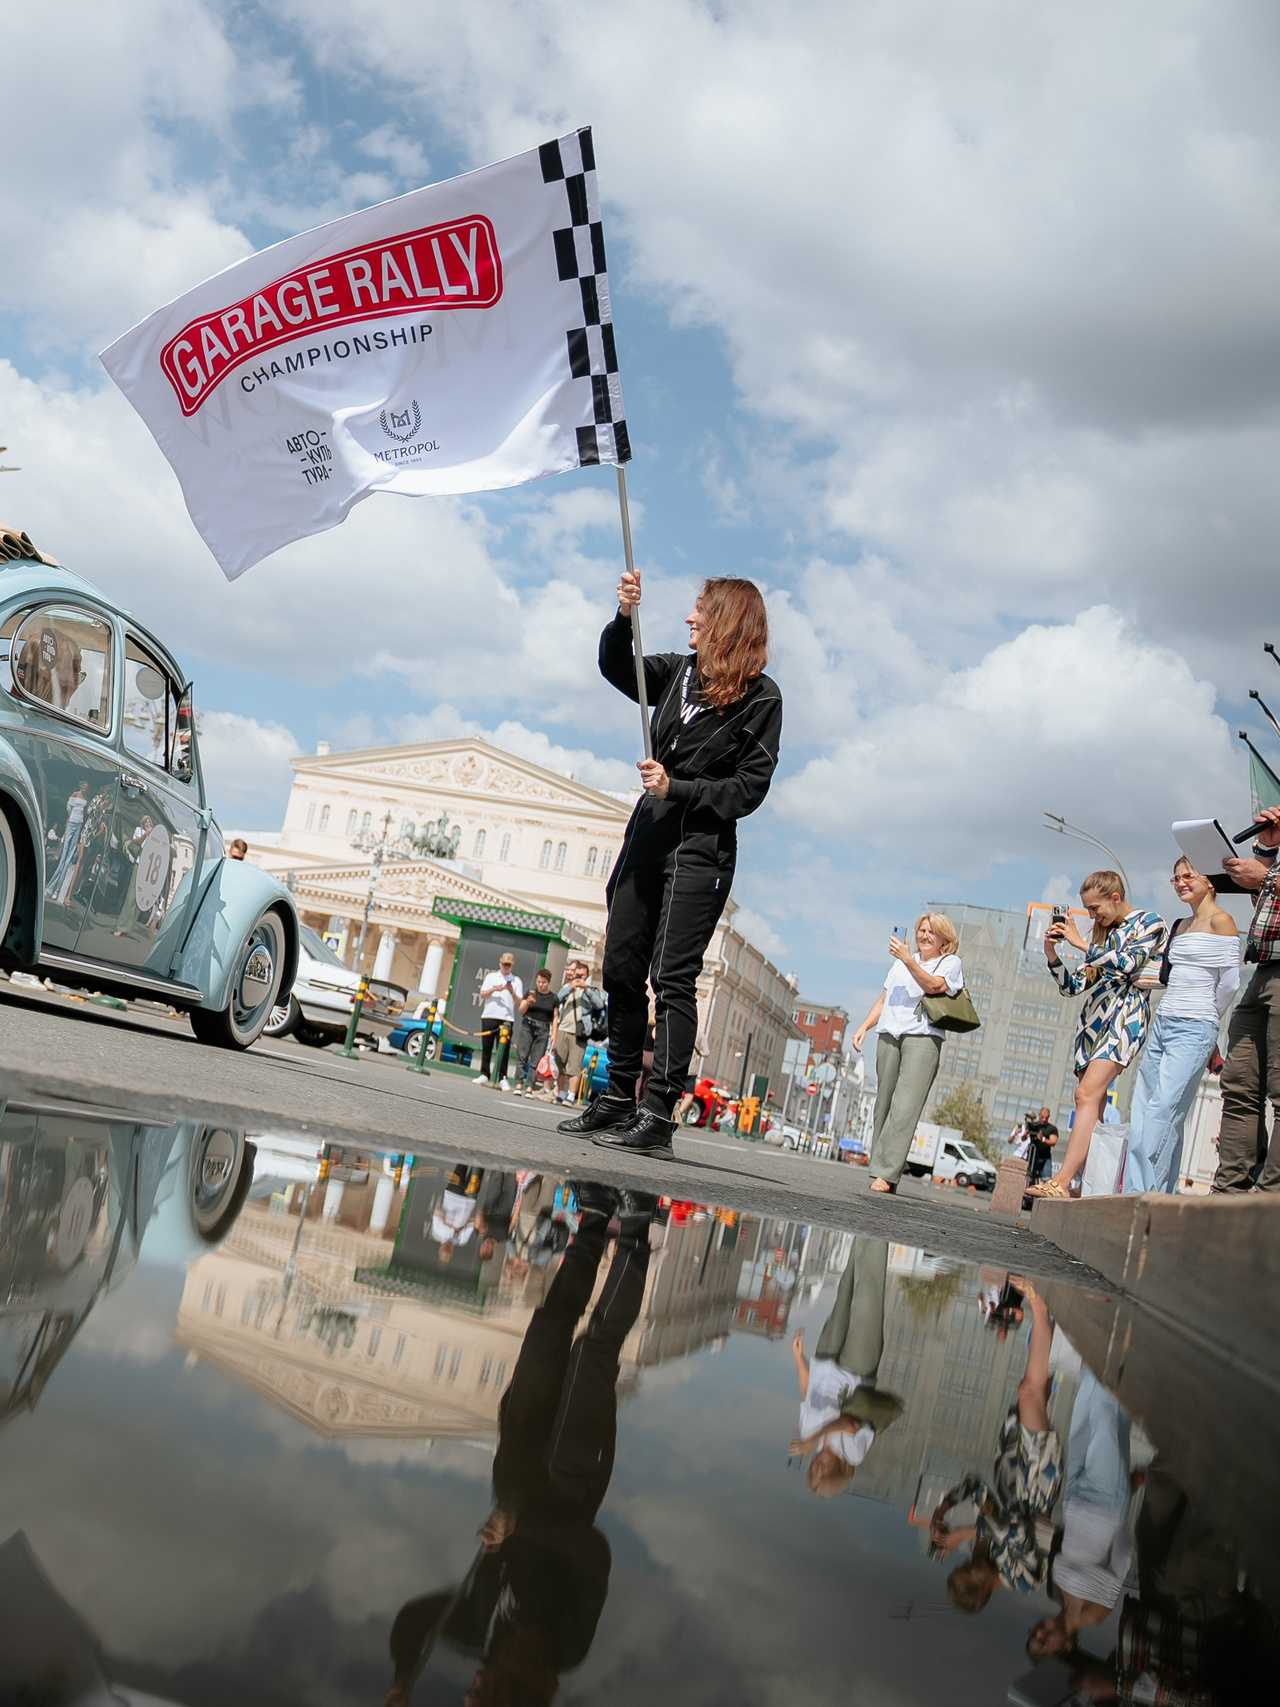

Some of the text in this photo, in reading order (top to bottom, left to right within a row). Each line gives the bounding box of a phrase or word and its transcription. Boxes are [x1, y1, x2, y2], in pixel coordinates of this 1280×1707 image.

[172, 227, 480, 398] GARAGE RALLY
[240, 324, 434, 393] CHAMPIONSHIP
[373, 440, 440, 462] METROPOL
[394, 459, 409, 467] SINCE
[145, 851, 162, 885] 18
